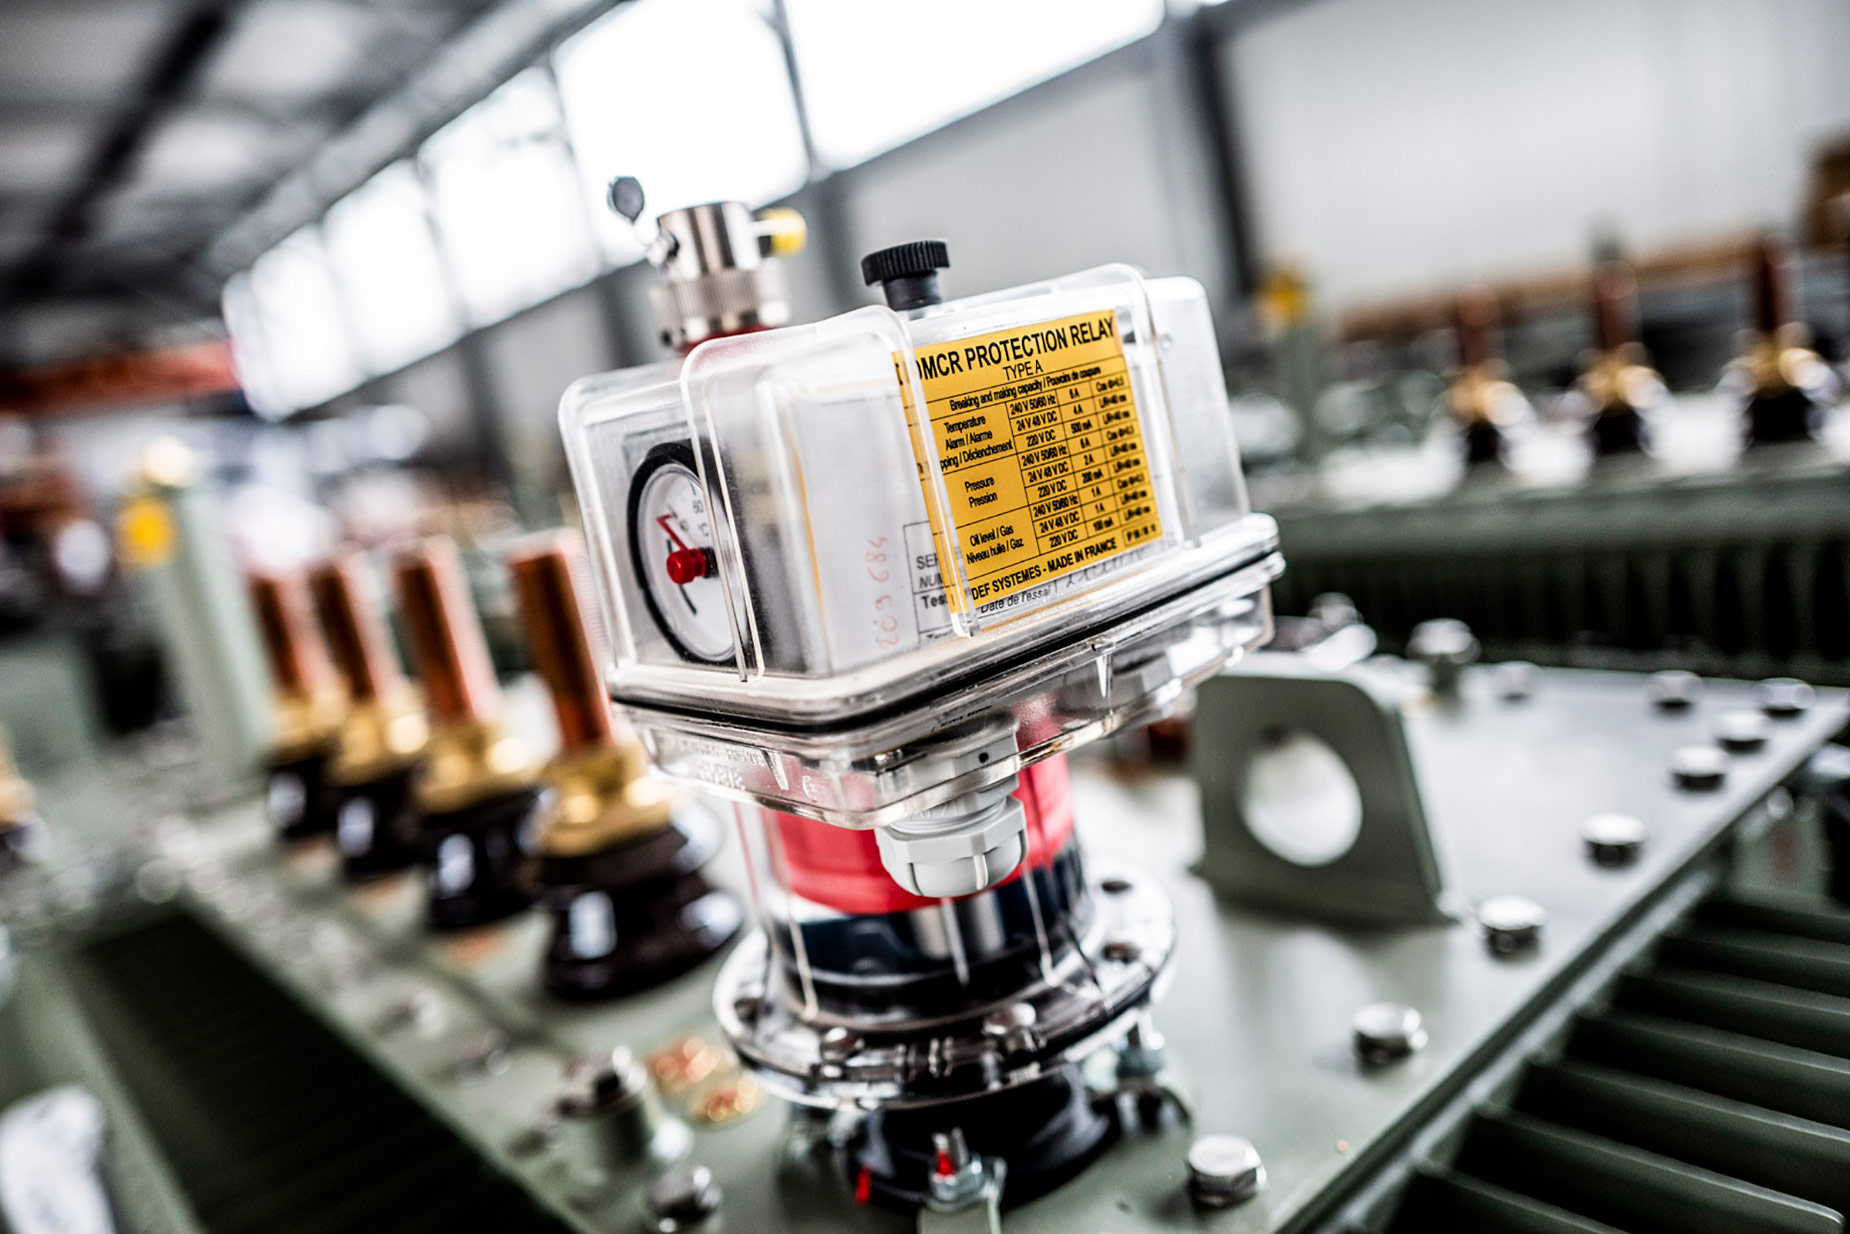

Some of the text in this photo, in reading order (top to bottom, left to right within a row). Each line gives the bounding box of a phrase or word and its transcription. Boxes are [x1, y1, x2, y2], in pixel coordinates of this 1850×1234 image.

[964, 327, 1068, 370] PROTECTION
[1069, 316, 1113, 346] RELAY
[1003, 359, 1043, 381] TYPE A
[949, 395, 980, 411] Breaking
[980, 391, 993, 403] and
[993, 386, 1017, 400] making
[1017, 379, 1042, 396] capacity
[1074, 387, 1080, 397] A
[1009, 402, 1023, 415] 240
[1022, 400, 1028, 411] V
[1047, 393, 1056, 405] Hz
[1078, 403, 1083, 414] A
[943, 416, 986, 433] Temperature
[1016, 410, 1057, 431] 24 V 48 V DC
[945, 437, 965, 451] Alarm
[969, 430, 993, 444] Alarme
[1026, 429, 1056, 447] 220 V DC
[940, 455, 959, 472] pping
[1021, 453, 1034, 466] 240
[1034, 451, 1039, 462] V
[1028, 471, 1037, 483] 24
[1036, 468, 1042, 480] V
[1051, 464, 1057, 475] V
[1058, 461, 1069, 474] DC
[964, 477, 994, 493] Pressure
[1037, 479, 1067, 498] 220 V DC
[968, 492, 998, 508] Pression
[1033, 504, 1046, 517] 240
[1045, 502, 1051, 513] V
[1039, 521, 1049, 533] 24
[1048, 518, 1054, 530] V
[1063, 514, 1069, 525] V
[1069, 510, 1080, 523] DC
[970, 533, 980, 546] Oil
[980, 528, 995, 544] level
[1000, 525, 1014, 537] Gas
[1049, 529, 1078, 548] 220 V DC
[966, 550, 990, 565] Niveau
[989, 543, 1006, 556] huile
[1010, 538, 1024, 549] Gaz
[971, 582, 990, 600] DEF
[992, 565, 1042, 592] SYSTEMES
[1047, 553, 1074, 572] MADE
[1074, 549, 1084, 563] IN
[1084, 537, 1117, 559] FRANCE
[921, 593, 948, 609] Tes
[1007, 594, 1019, 607] de
